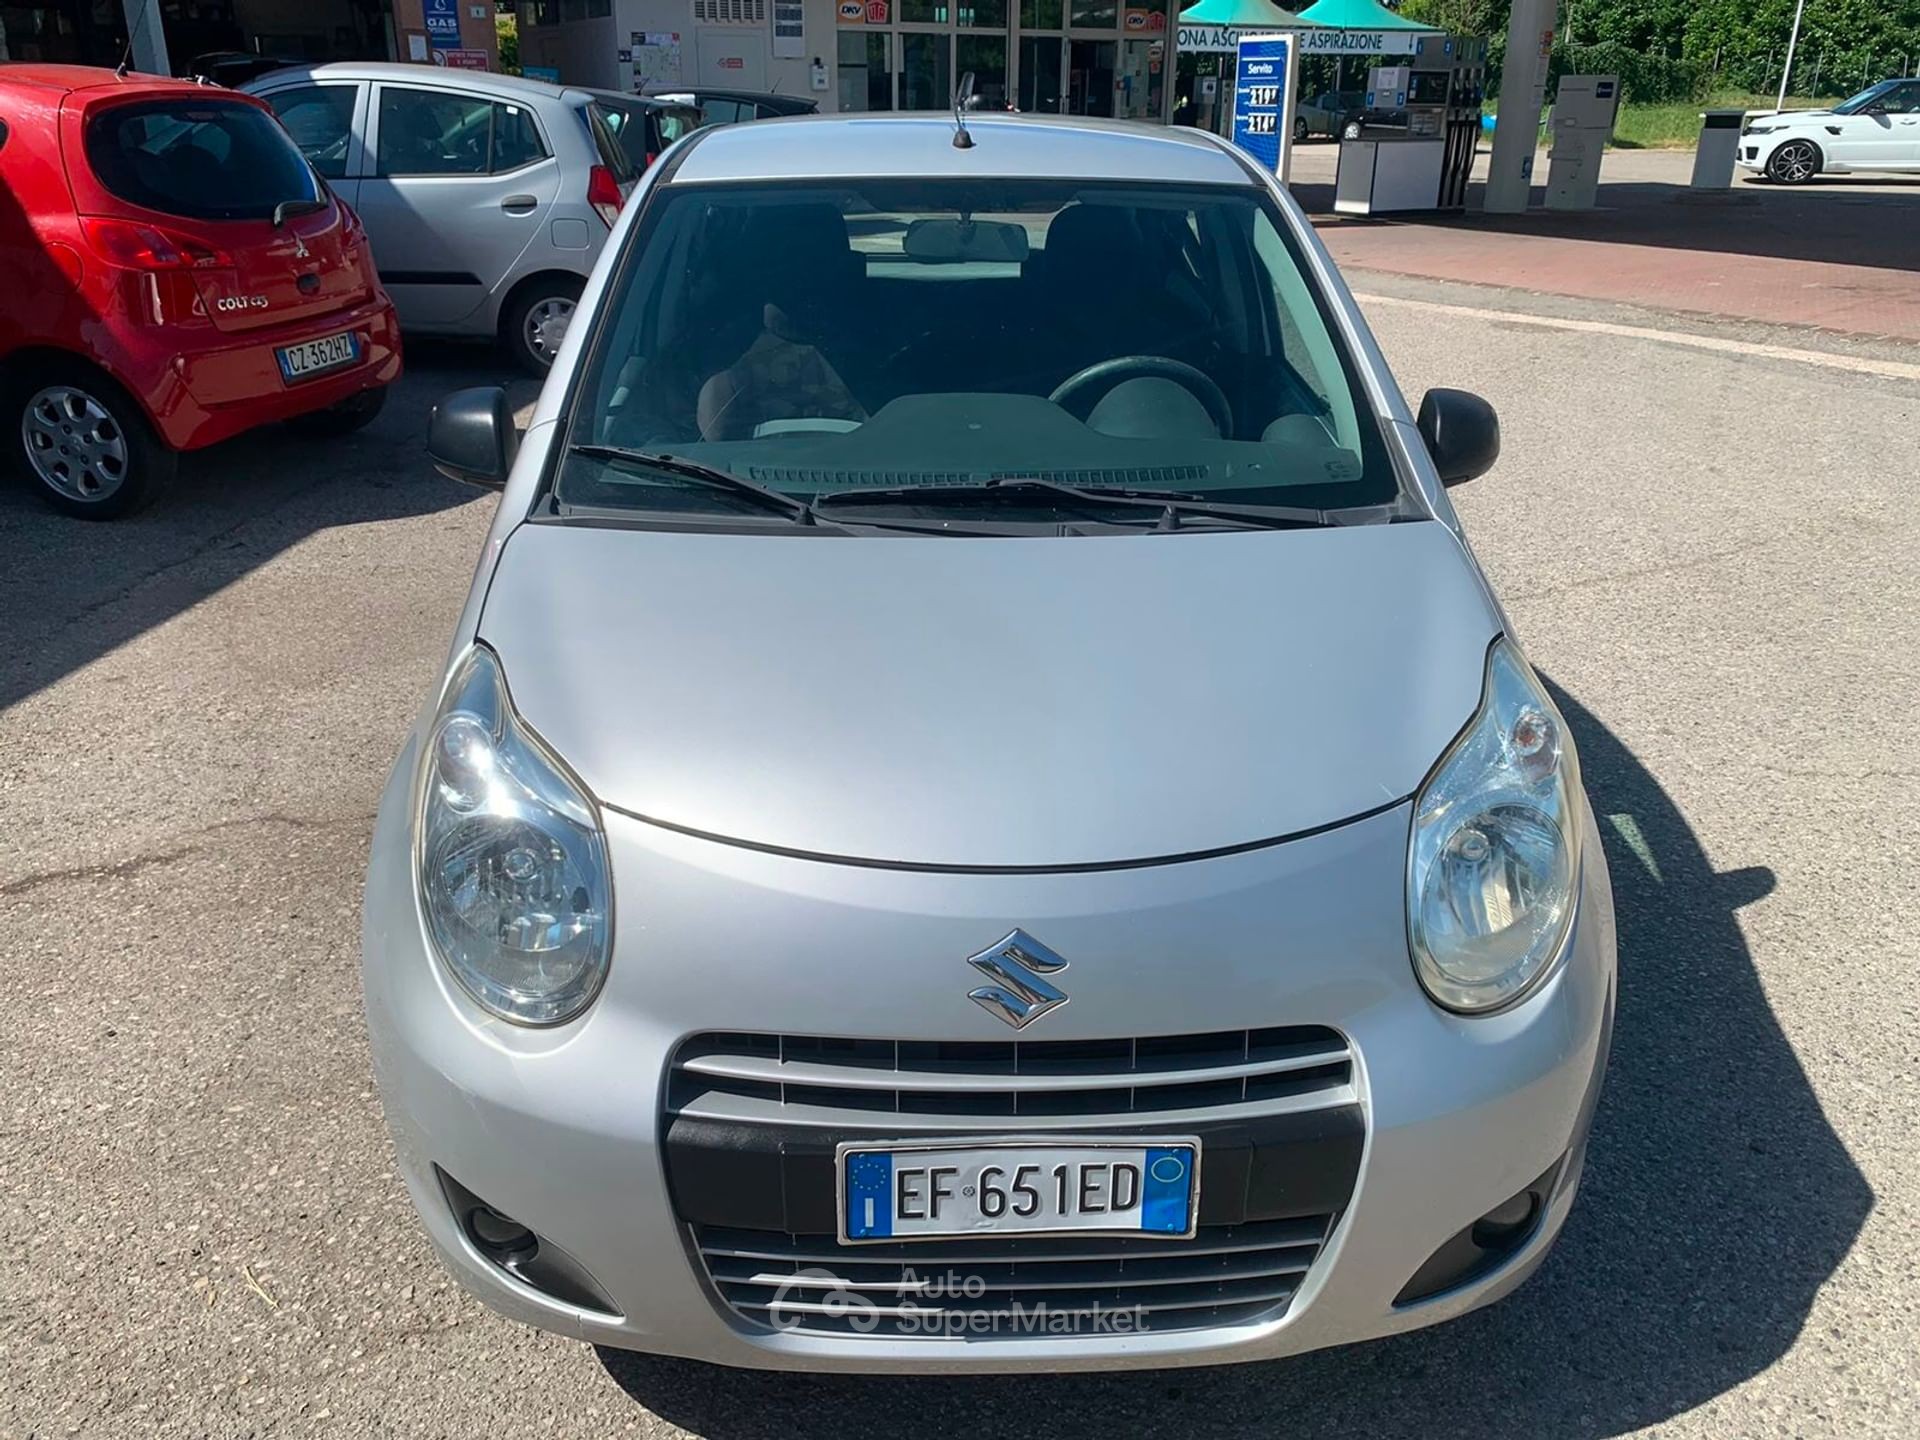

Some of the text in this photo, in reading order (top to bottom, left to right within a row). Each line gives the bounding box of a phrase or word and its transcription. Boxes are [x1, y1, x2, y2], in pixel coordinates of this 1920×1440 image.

[842, 5, 862, 15] DKV
[427, 18, 457, 27] GAS
[1177, 29, 1207, 46] ONA
[1308, 32, 1383, 49] ASPIRAZIONE
[1247, 63, 1273, 74] Servito
[217, 296, 248, 311] COLT
